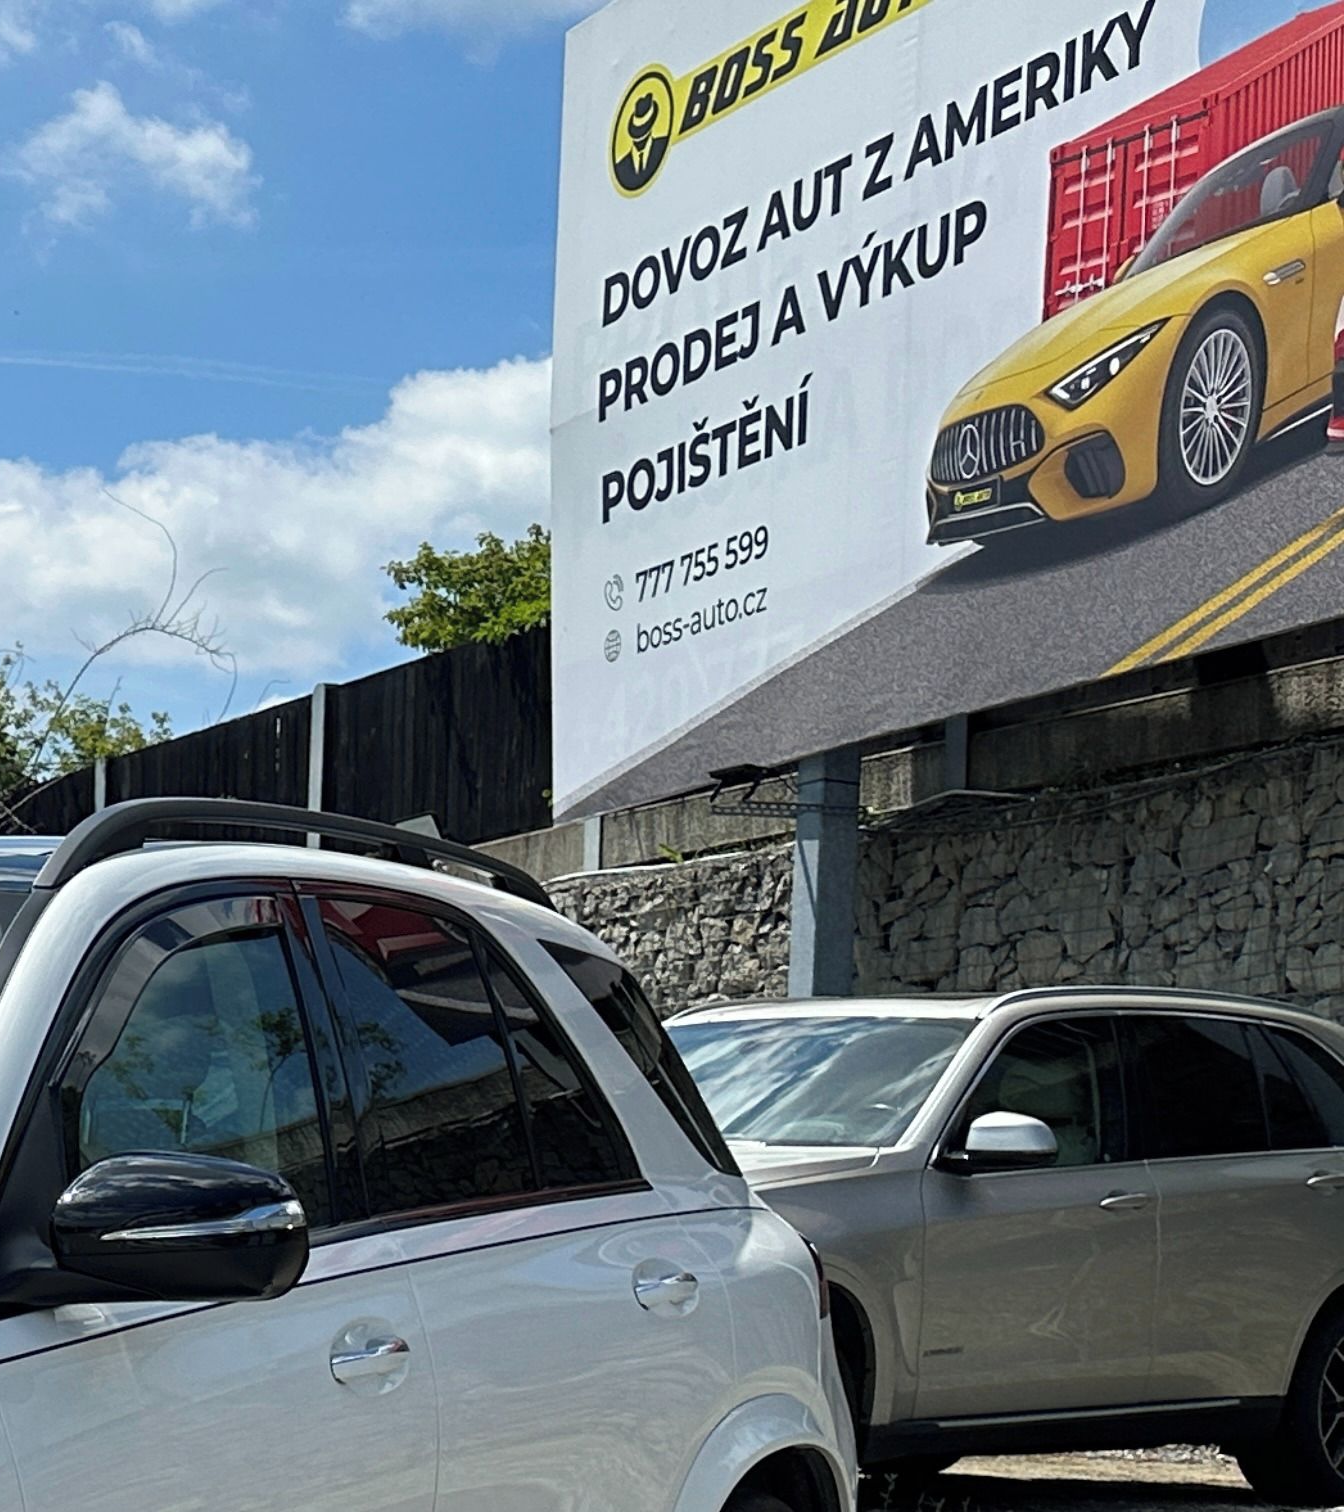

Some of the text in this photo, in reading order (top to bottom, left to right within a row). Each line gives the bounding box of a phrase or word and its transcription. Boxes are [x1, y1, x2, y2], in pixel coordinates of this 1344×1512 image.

[678, 10, 809, 136] BOSS
[601, 0, 1157, 328] DOVOZ AUT Z AMERIKY
[598, 200, 988, 424] PRODEJ A VÝKUP
[601, 372, 814, 525] POJIŠTĚNÍ
[635, 525, 769, 603] 777 755 599
[636, 587, 768, 655] boss-auto.cz
